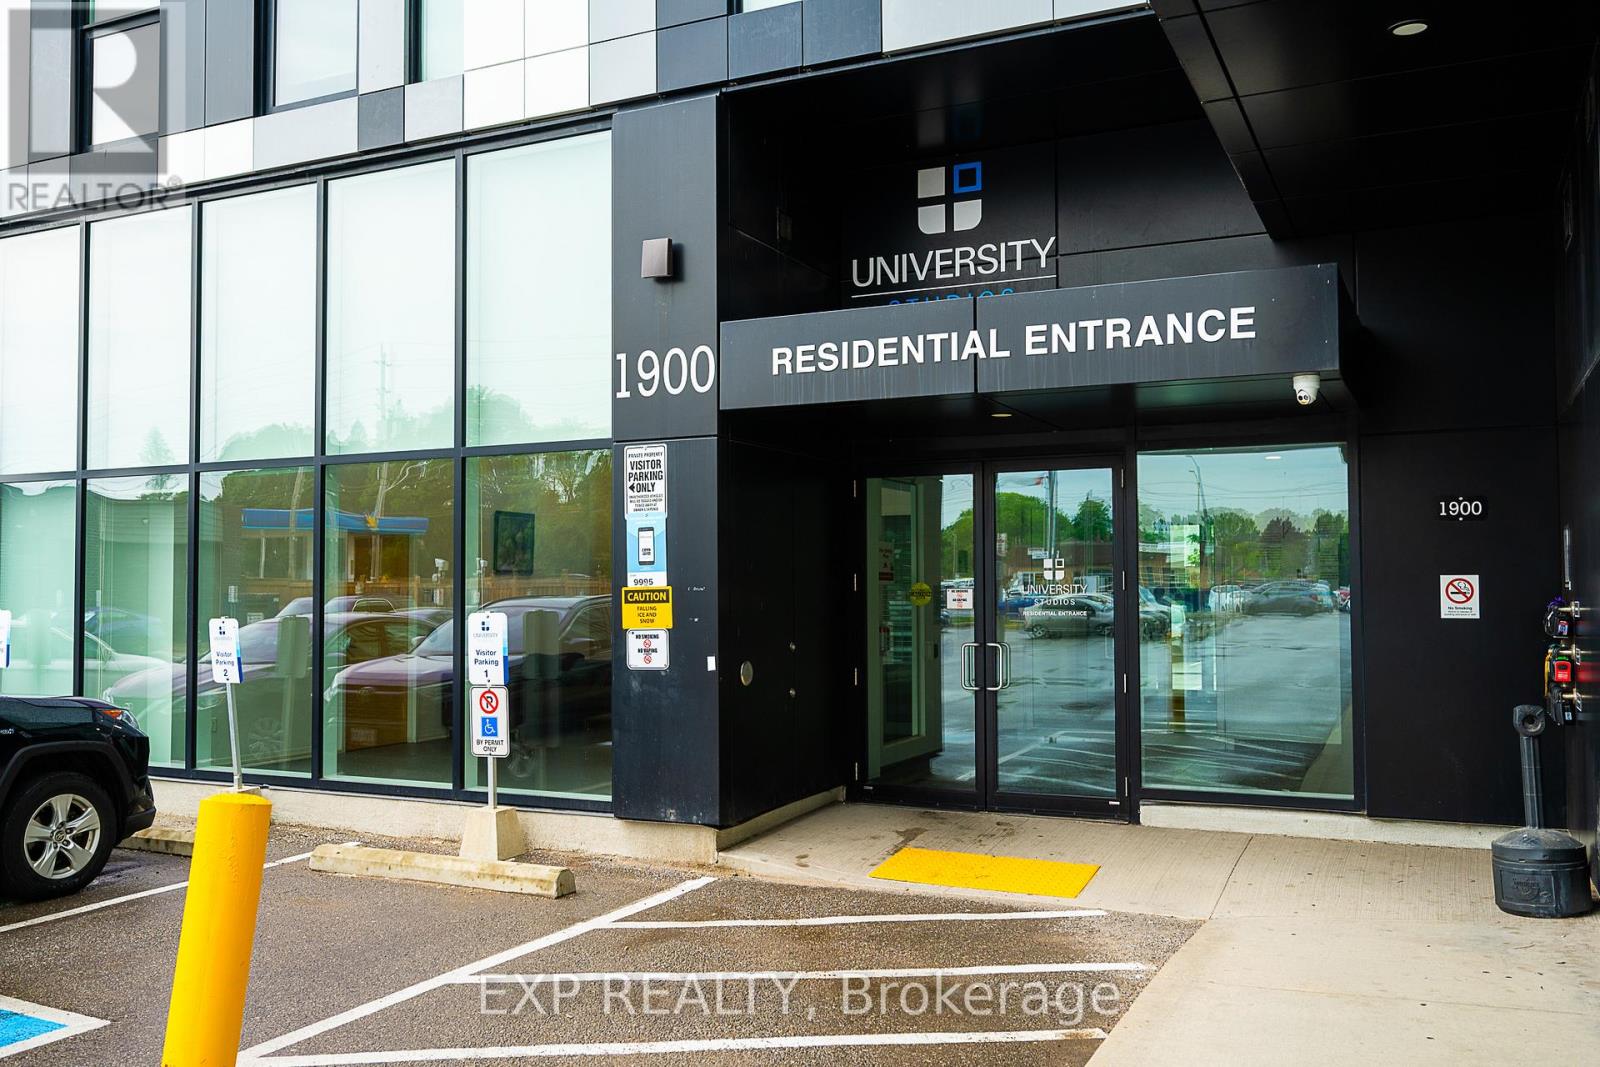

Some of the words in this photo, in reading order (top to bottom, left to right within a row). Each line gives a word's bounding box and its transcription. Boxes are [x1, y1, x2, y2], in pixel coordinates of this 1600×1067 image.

[852, 236, 1056, 287] UNIVERSITY
[772, 328, 1010, 376] RESIDENTIAL
[1024, 306, 1256, 355] ENTRANCE
[614, 345, 716, 399] 1900
[630, 459, 662, 470] VISITOR
[628, 470, 664, 482] PARKING
[635, 482, 656, 493] ONLY
[1439, 501, 1482, 516] 1900
[1021, 584, 1088, 595] UNIVERSITY
[627, 592, 667, 602] CAUTION
[1034, 598, 1076, 606] STUDIOS
[474, 658, 499, 666] Parking
[484, 669, 489, 678] 1
